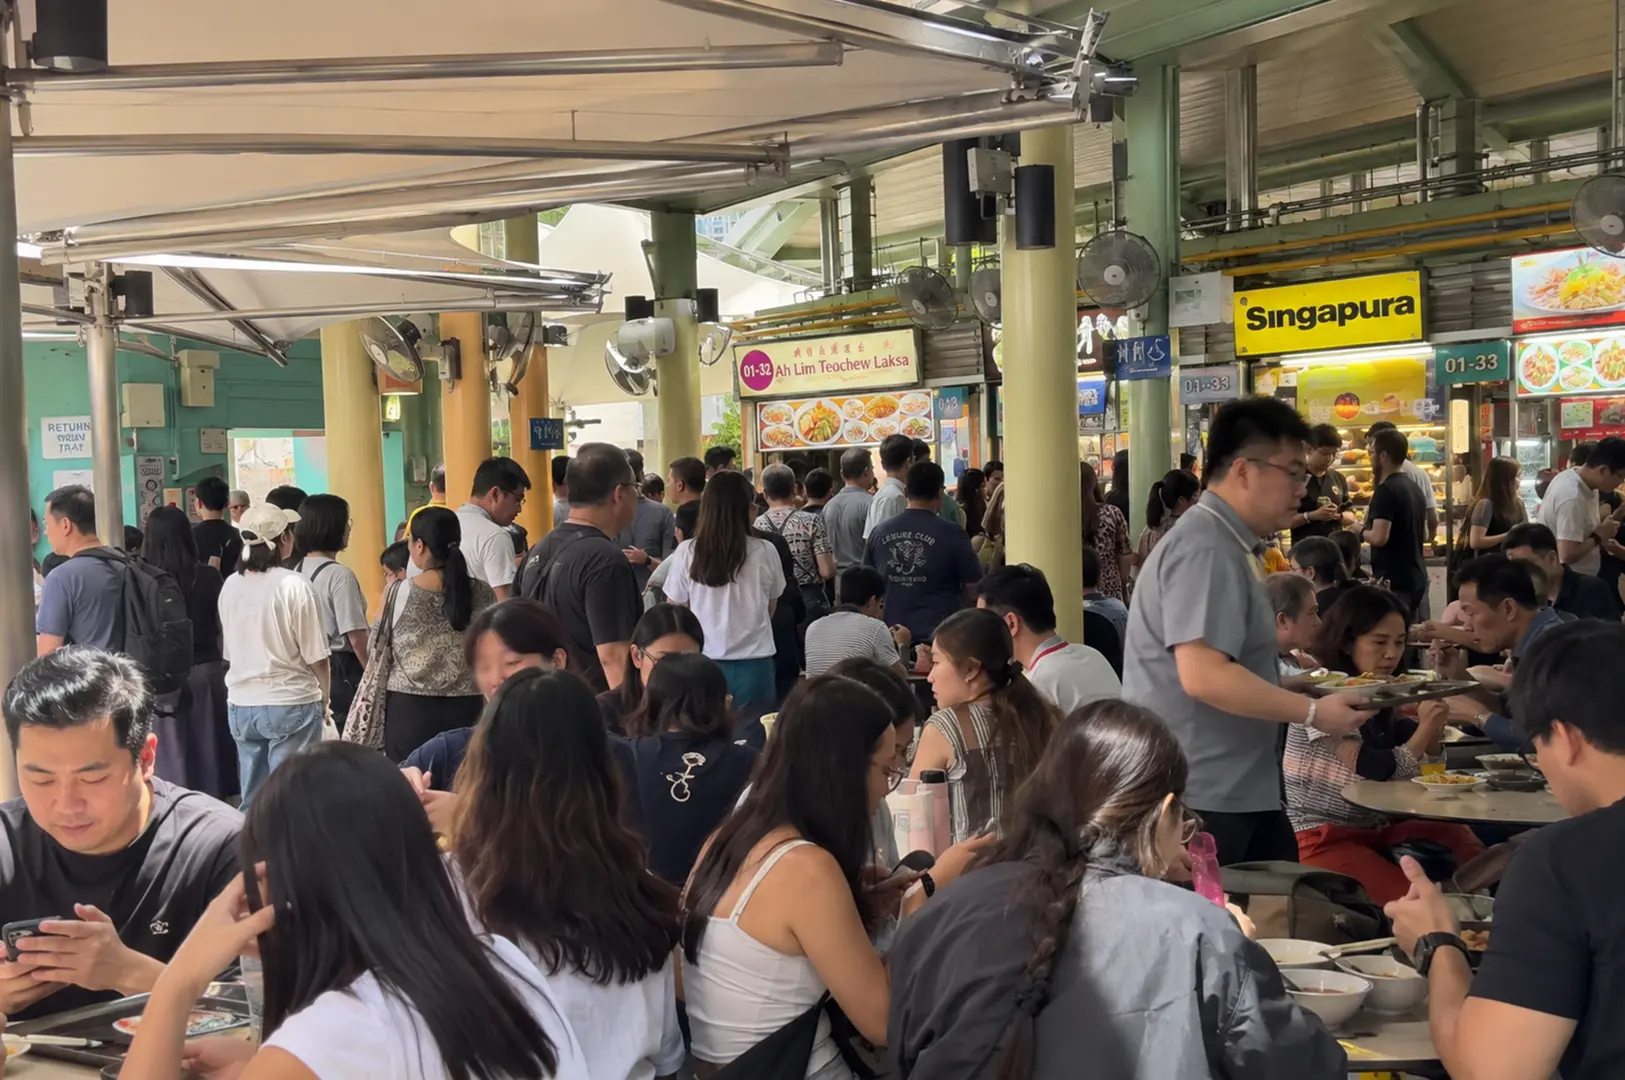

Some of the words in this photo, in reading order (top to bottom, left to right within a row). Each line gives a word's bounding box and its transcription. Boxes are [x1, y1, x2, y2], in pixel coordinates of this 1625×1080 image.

[1246, 295, 1415, 331] Singapura
[743, 363, 772, 378] 01-32
[775, 364, 791, 377] Ah
[794, 362, 816, 376] Lim
[818, 358, 871, 373] Teochew
[874, 354, 909, 369] Laksa
[1445, 353, 1499, 373] 01-33
